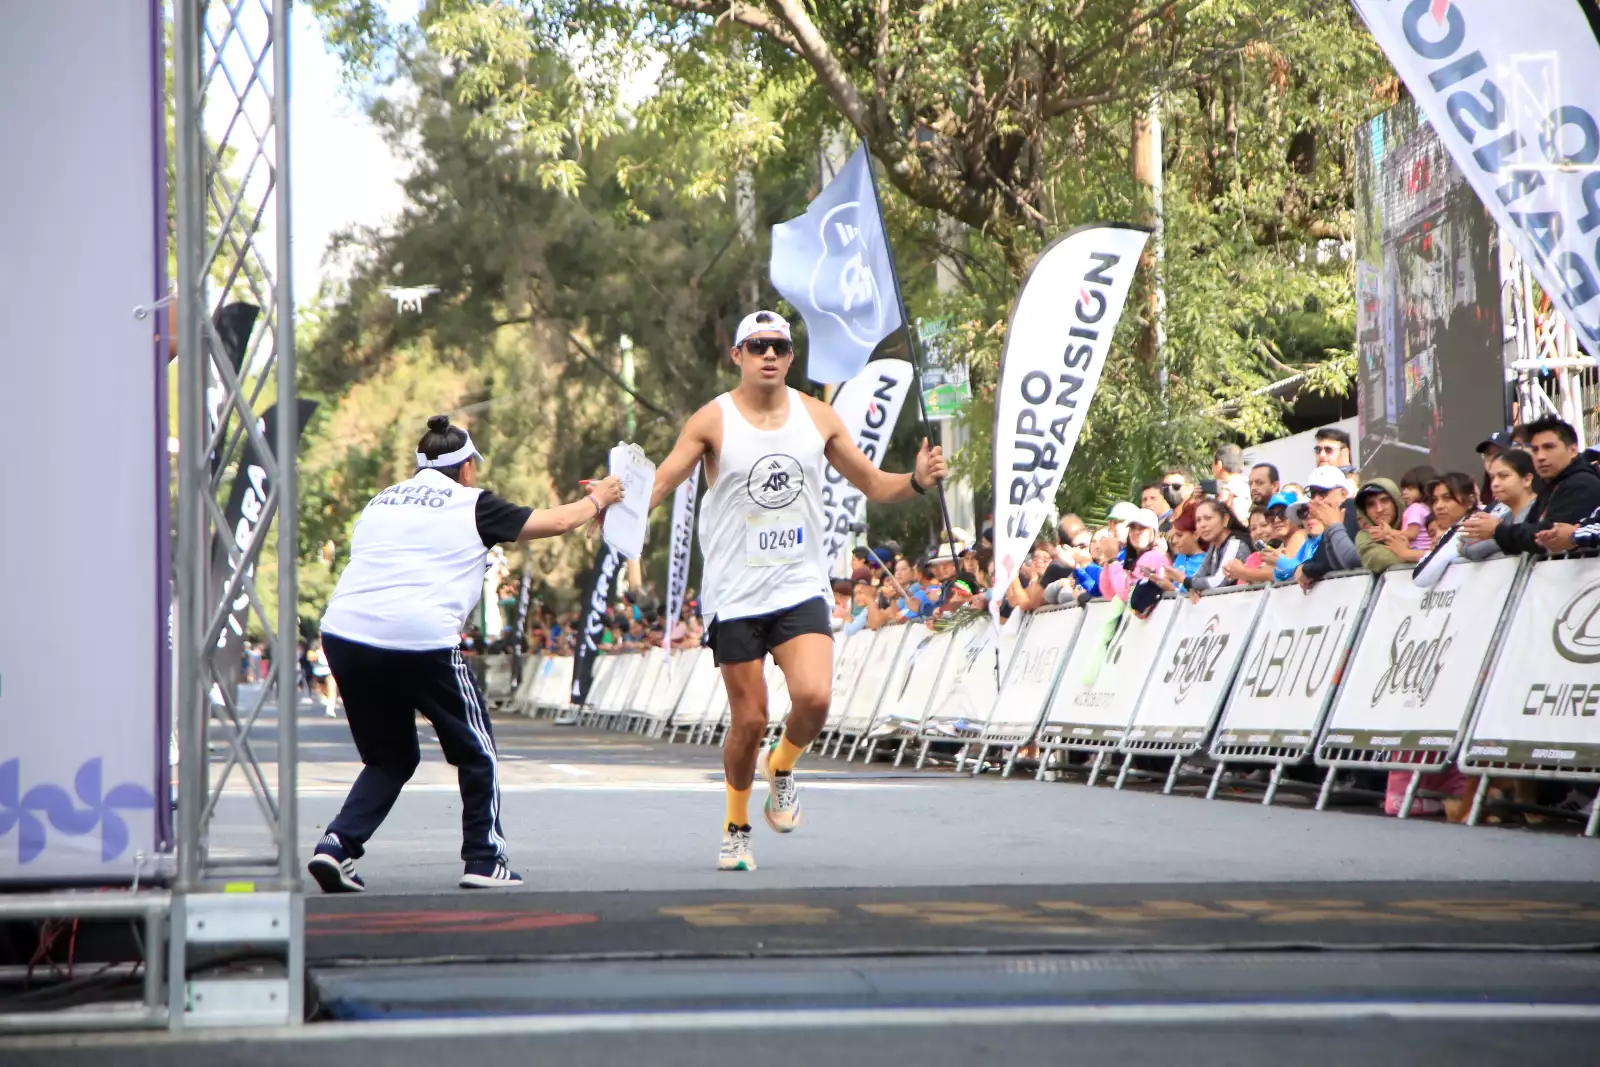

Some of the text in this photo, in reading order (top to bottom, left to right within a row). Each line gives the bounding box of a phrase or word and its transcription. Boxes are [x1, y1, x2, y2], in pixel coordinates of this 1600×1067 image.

[369, 495, 445, 508] VALERO
[759, 529, 796, 550] 0249
[1164, 631, 1230, 684] SHOKZ
[1370, 613, 1453, 708] Seeds
